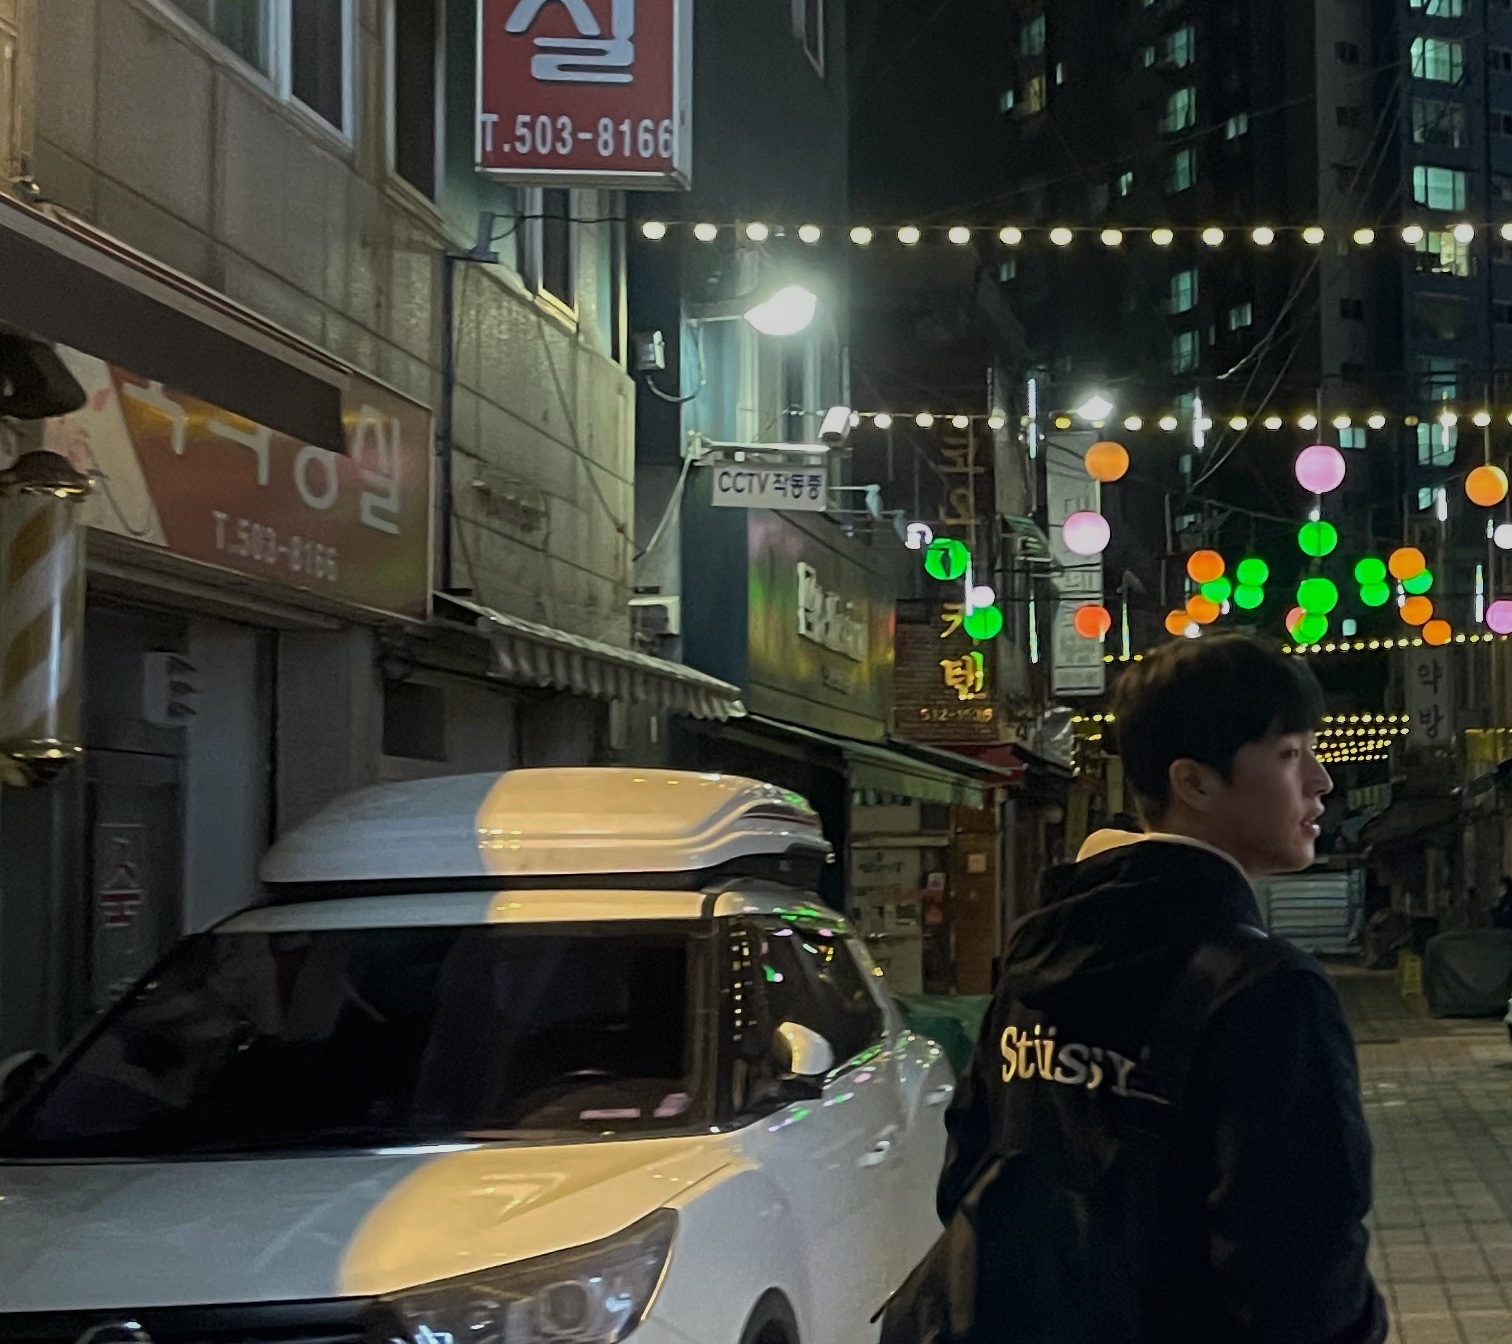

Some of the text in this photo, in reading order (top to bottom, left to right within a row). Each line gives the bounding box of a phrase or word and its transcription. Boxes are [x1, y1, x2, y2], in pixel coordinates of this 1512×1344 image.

[481, 111, 675, 159] T.503-8166
[718, 471, 823, 501] CCTV 작동중
